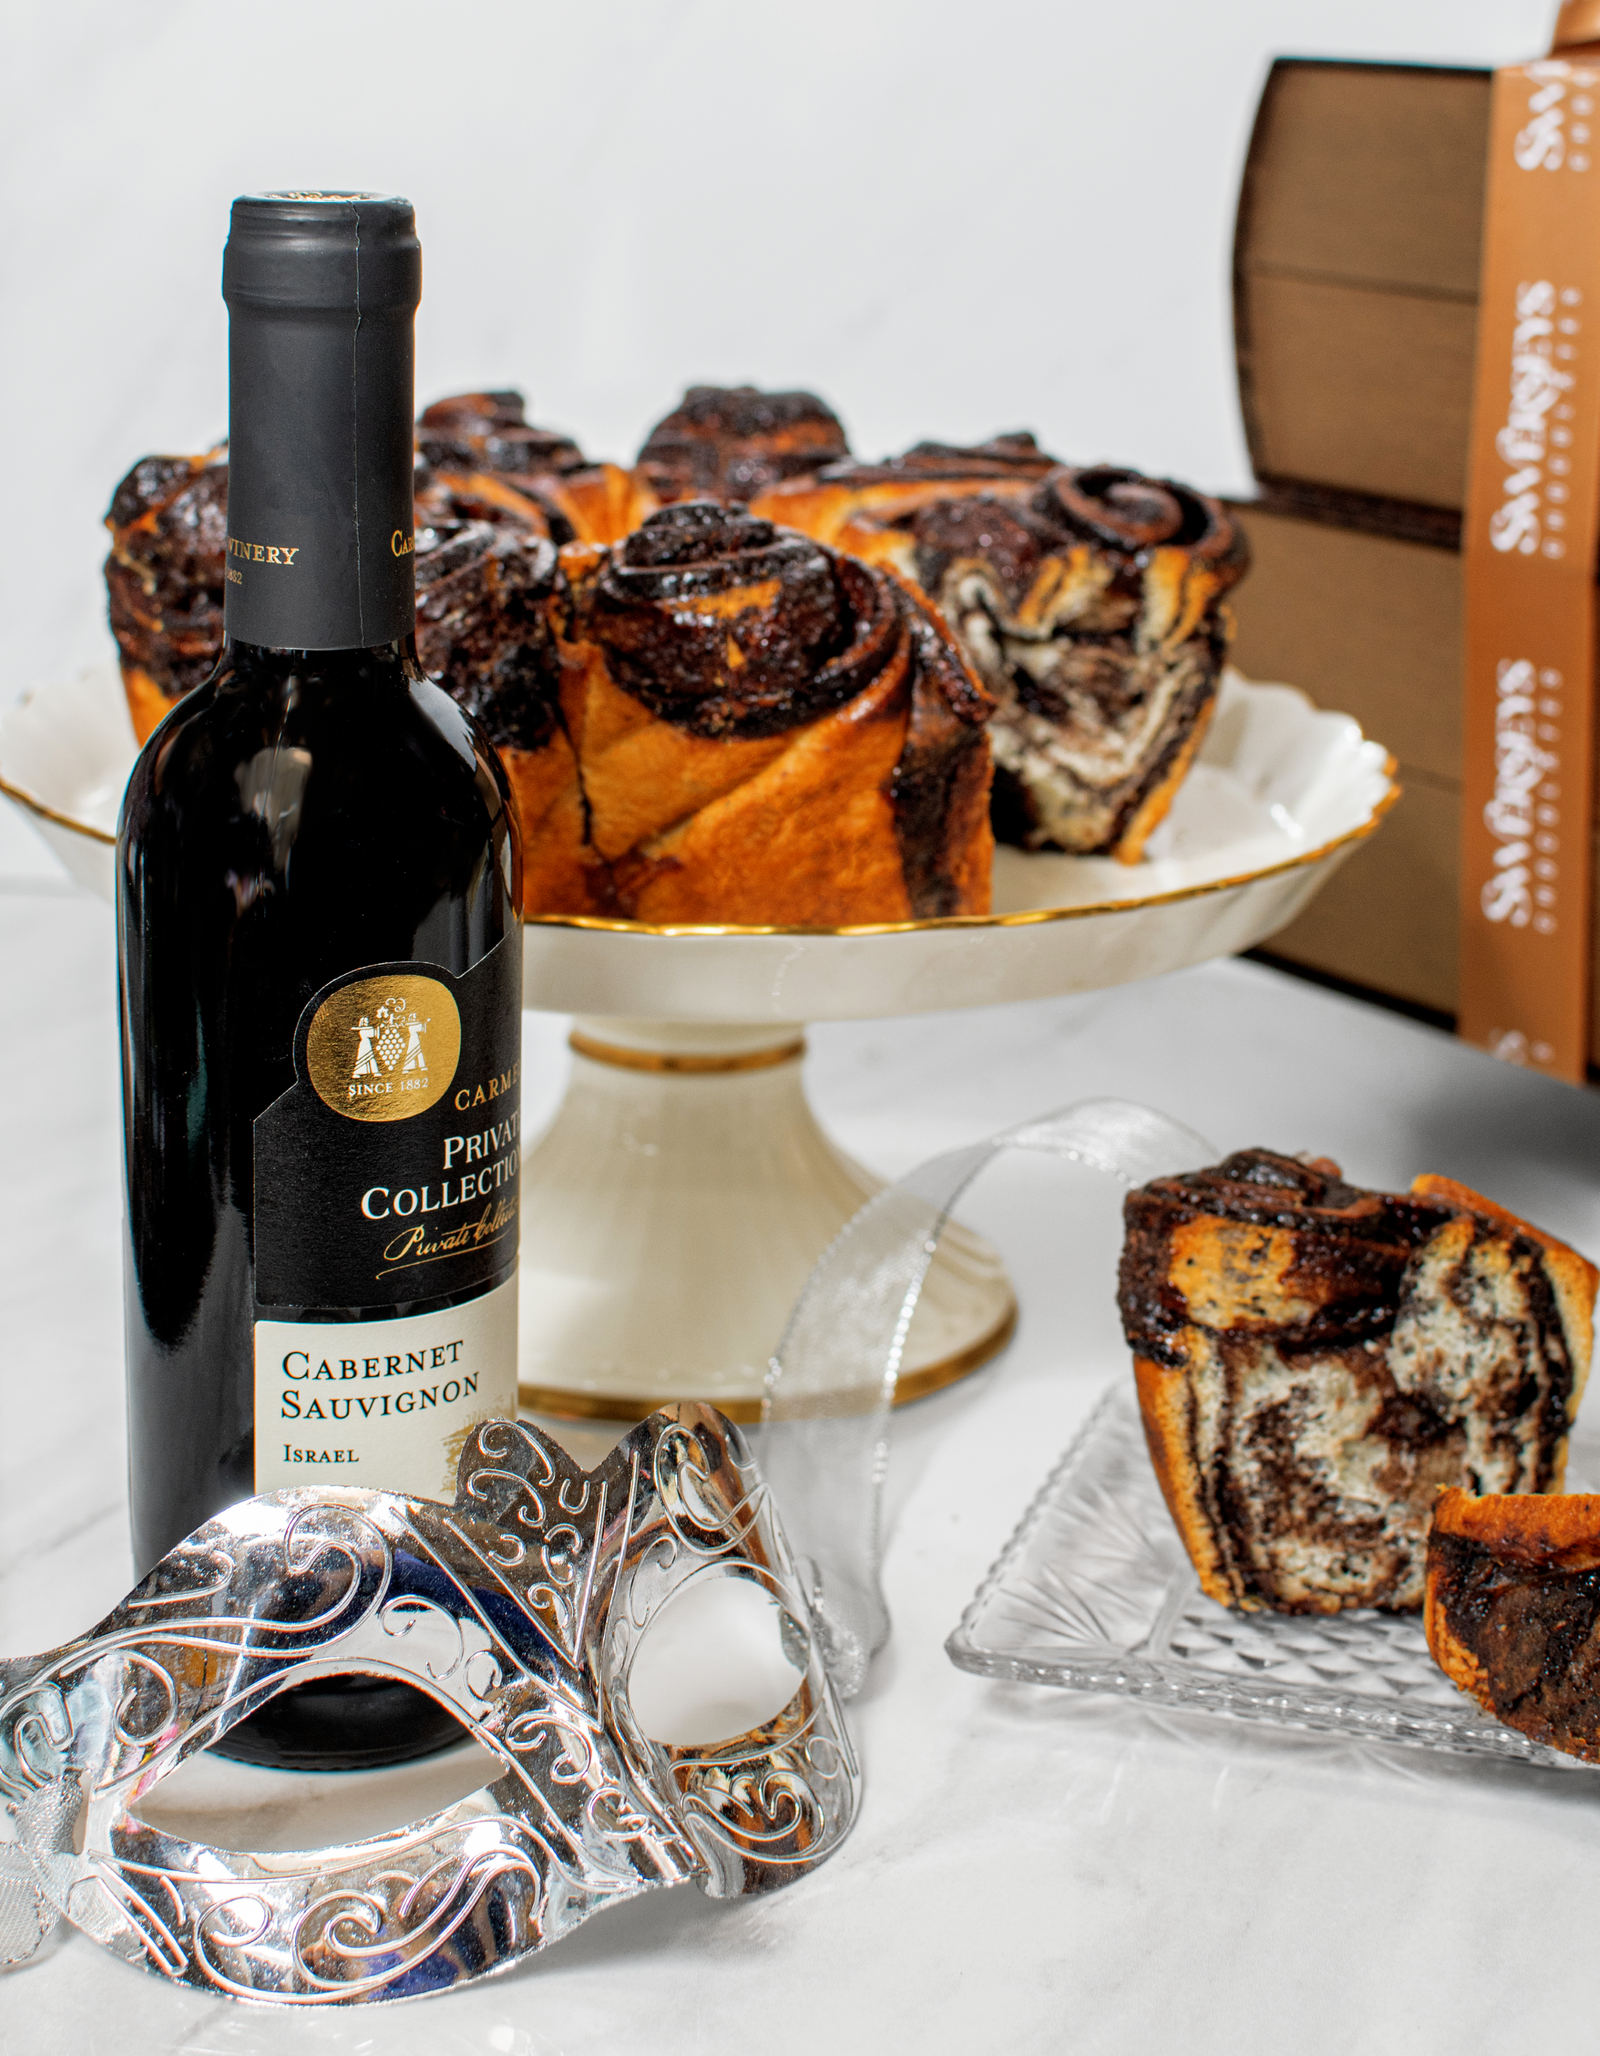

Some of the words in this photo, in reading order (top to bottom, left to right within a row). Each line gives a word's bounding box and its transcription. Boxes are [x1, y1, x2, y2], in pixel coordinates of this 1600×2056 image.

[348, 1082, 393, 1098] SINCE
[400, 1077, 429, 1092] 1882
[443, 1108, 519, 1170] PRIVAT
[383, 1222, 478, 1261] Private
[281, 1339, 464, 1381] CABERNET
[281, 1370, 480, 1420] SAUVIGNON
[283, 1443, 360, 1463] ISRAEL
